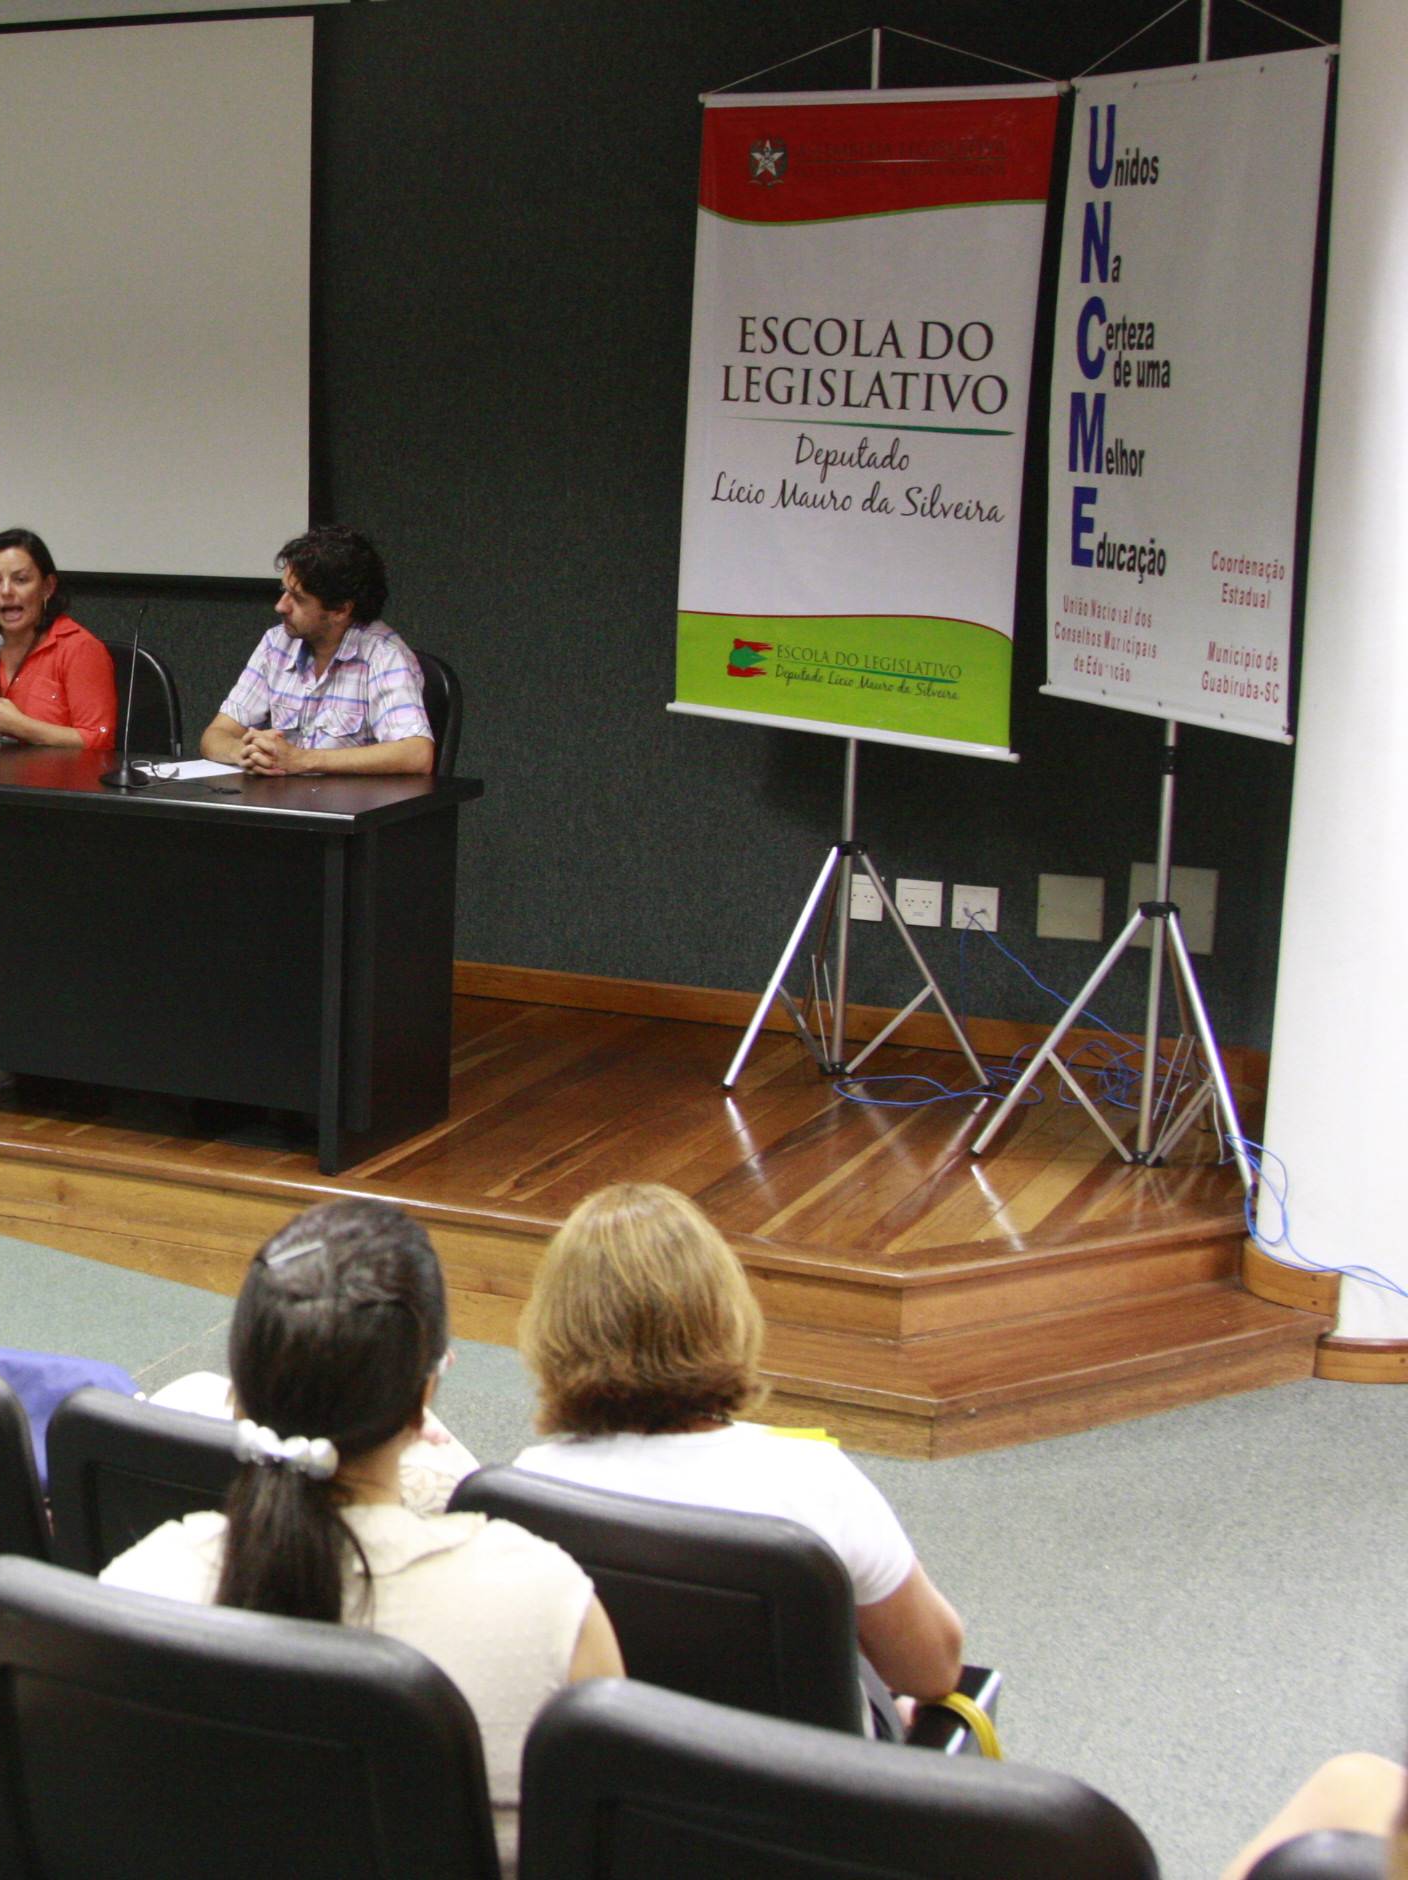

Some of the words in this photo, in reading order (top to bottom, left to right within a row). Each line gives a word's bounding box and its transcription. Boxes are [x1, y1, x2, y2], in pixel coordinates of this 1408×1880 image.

[738, 316, 906, 358] ESCOLA
[918, 320, 994, 361] DO
[1113, 351, 1132, 388] de
[1136, 359, 1171, 388] uma
[721, 365, 1009, 415] LEGISLATIVO
[795, 433, 910, 484] Deputado
[711, 471, 765, 505] Lício
[771, 479, 853, 511] Mauro
[861, 481, 895, 515] da
[900, 484, 1005, 523] Silveira
[1211, 550, 1286, 583] Coordenação
[1221, 582, 1272, 610] Estadual
[1054, 621, 1102, 648] Conselhos
[1135, 606, 1152, 628] dos
[777, 644, 830, 664] ESCOLA
[835, 651, 859, 668] DO
[864, 654, 962, 680] LEGISLATIVO
[1074, 653, 1084, 672] de
[1265, 651, 1279, 672] de
[775, 663, 823, 687] Deputado
[858, 674, 894, 692] Mauro
[897, 679, 911, 695] da
[914, 682, 960, 700] Silveira
[1201, 670, 1280, 704] Guabiruba-SC
